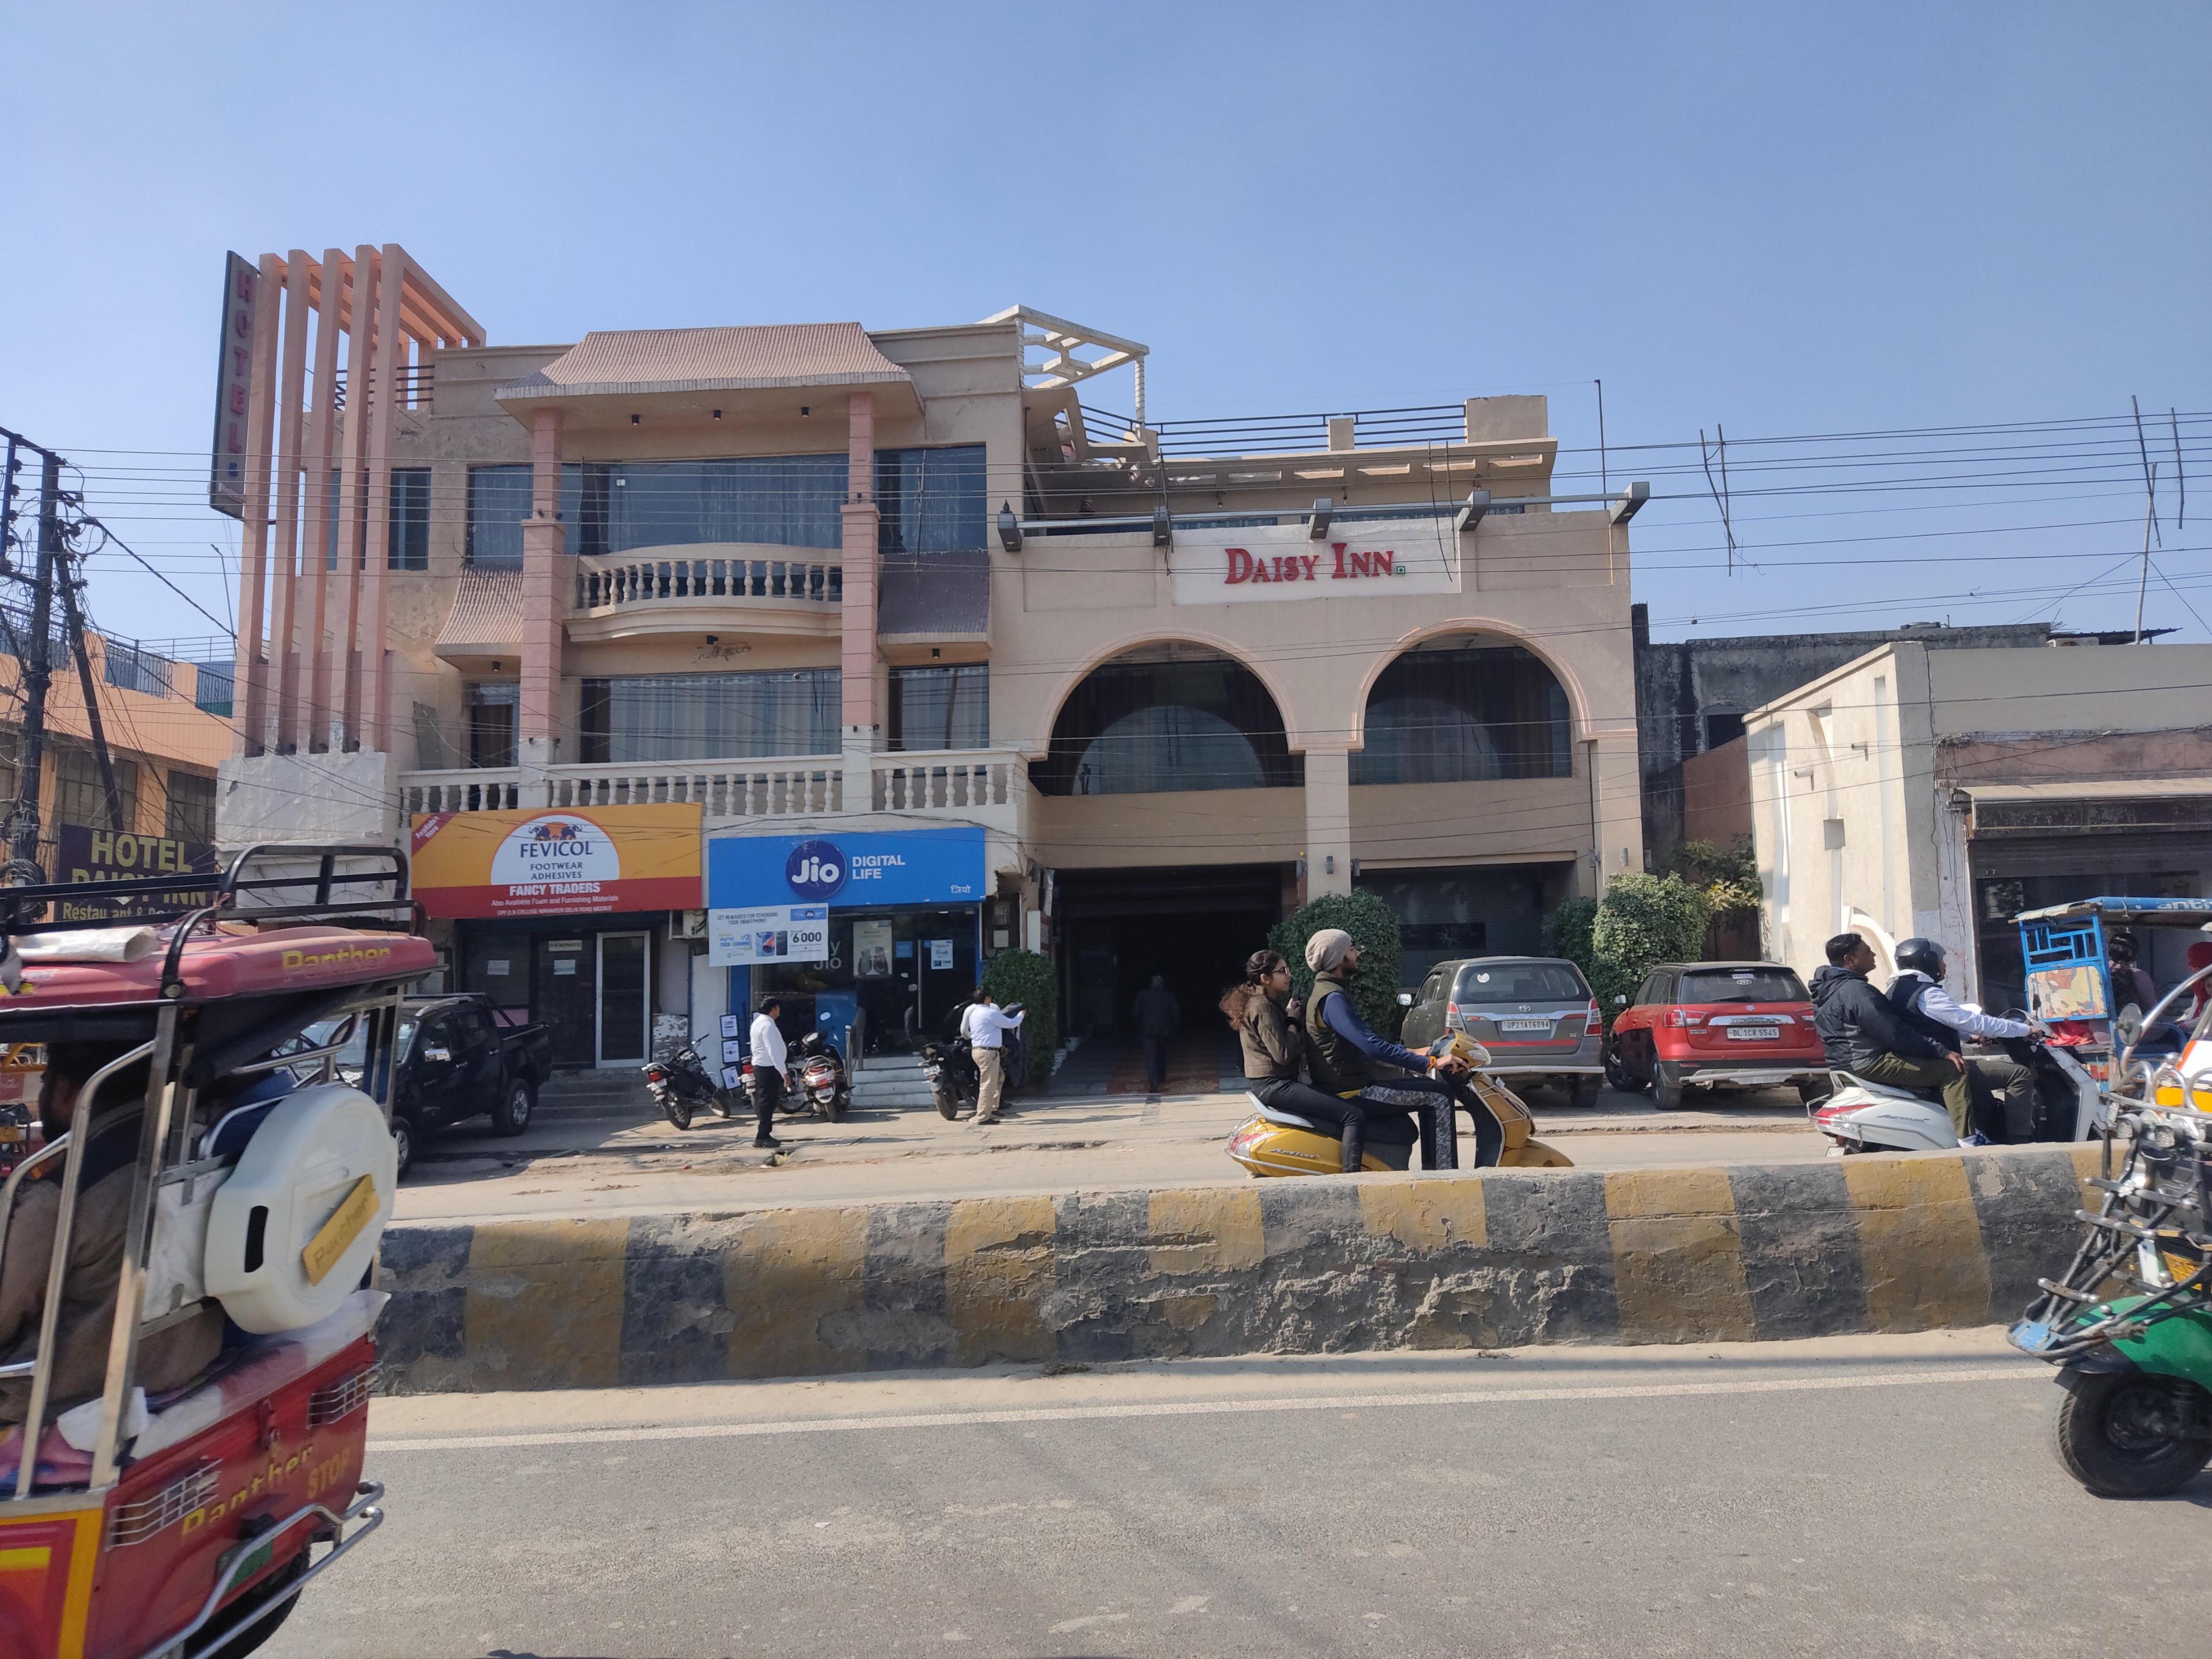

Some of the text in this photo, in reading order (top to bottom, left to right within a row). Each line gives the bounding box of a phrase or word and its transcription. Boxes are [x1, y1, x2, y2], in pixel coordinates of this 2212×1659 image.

[1224, 543, 1395, 584] DAISY INN
[91, 830, 193, 873] HOTEL
[520, 841, 593, 858] FEVICOL
[530, 862, 583, 871] FOOTWEAR
[852, 854, 906, 868] DIGITAL
[531, 872, 582, 880] ADHESIVES
[791, 856, 840, 884] Jio
[852, 868, 882, 880] LIFE
[509, 882, 601, 896] FANCY TRADERS
[950, 884, 971, 894] जियो
[62, 902, 132, 920] Restauant
